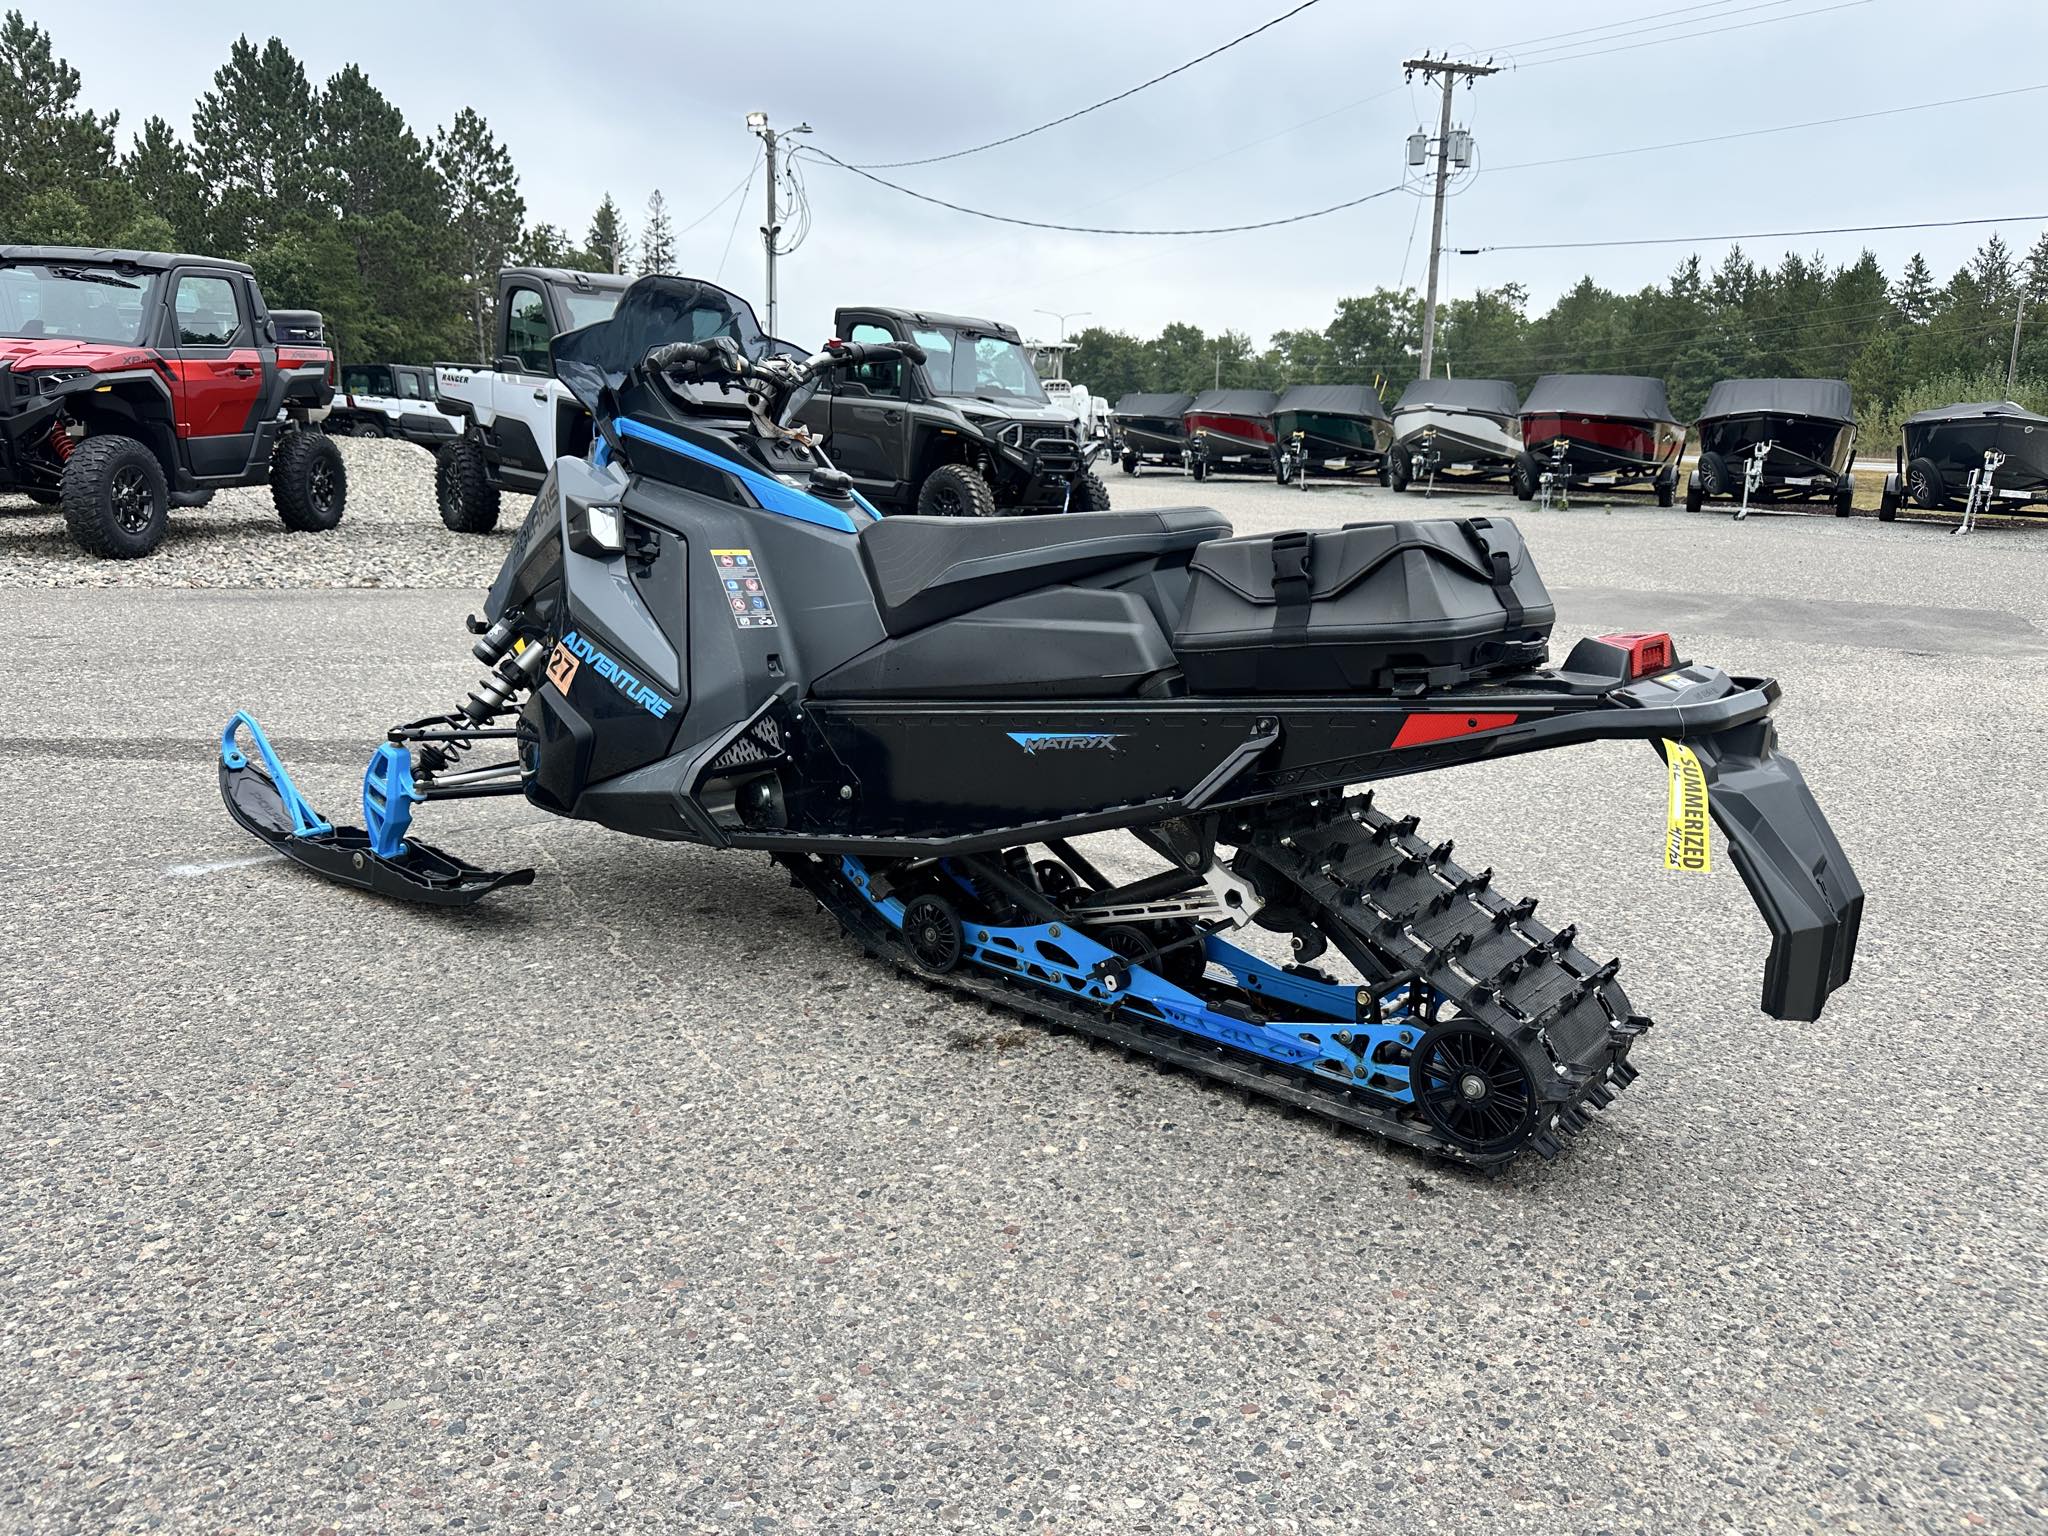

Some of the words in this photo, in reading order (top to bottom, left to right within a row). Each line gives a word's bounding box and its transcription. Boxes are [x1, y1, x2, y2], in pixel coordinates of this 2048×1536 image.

[441, 374, 469, 384] RANGER
[512, 482, 560, 569] POLARIS
[549, 648, 574, 683] 27
[561, 631, 673, 720] ADVENTURE
[1023, 736, 1118, 754] MATRYX
[1680, 757, 1705, 869] SUMMERIZED
